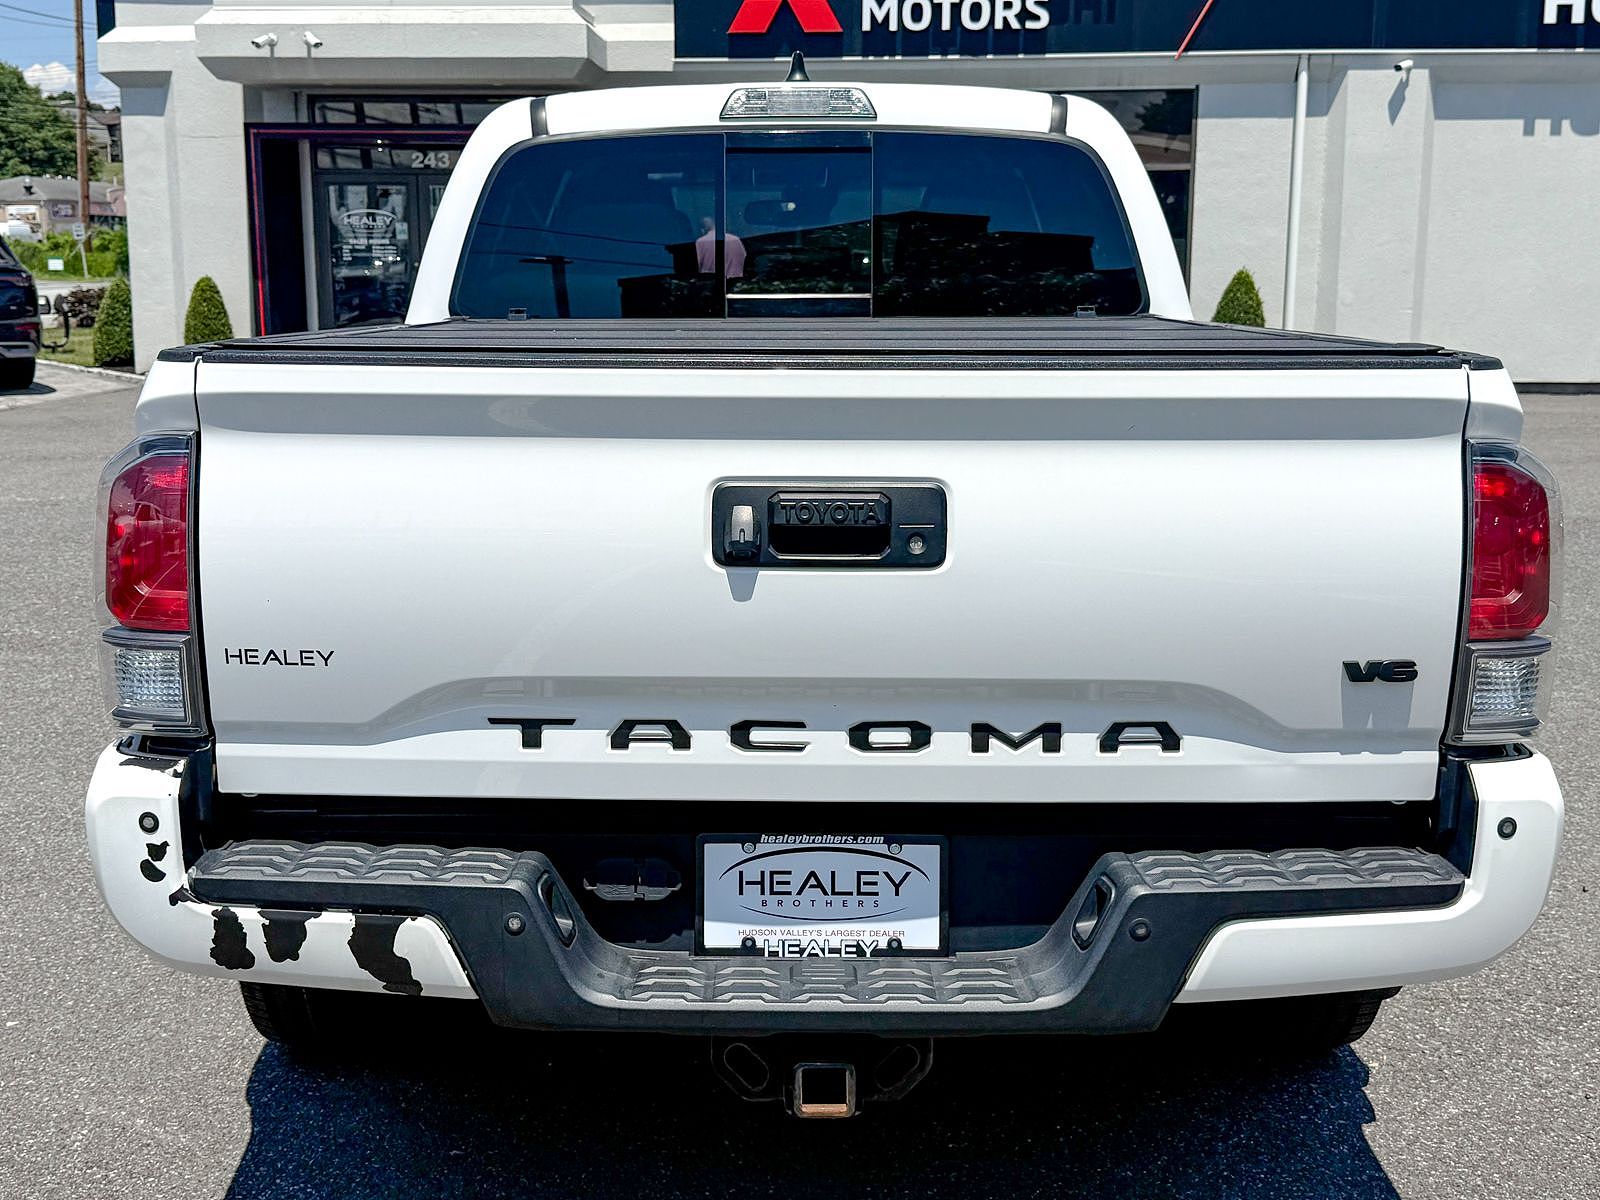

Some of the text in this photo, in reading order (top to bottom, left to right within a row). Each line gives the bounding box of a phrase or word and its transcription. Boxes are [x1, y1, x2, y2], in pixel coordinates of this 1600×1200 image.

[862, 0, 1050, 32] MOTORS
[411, 152, 450, 168] 243
[343, 216, 392, 225] HEALEY
[780, 502, 881, 525] TOYOTA
[224, 648, 335, 667] HEALEY
[1342, 659, 1418, 682] V6
[487, 718, 1184, 754] TACOMA
[760, 834, 885, 845] healeybrothers.com
[738, 870, 912, 897] HEALEY
[761, 899, 880, 908] BROTHERS
[738, 929, 905, 938] HUDSON VALLEY'S LARGEST DEALER
[764, 939, 879, 958] HEALEY
